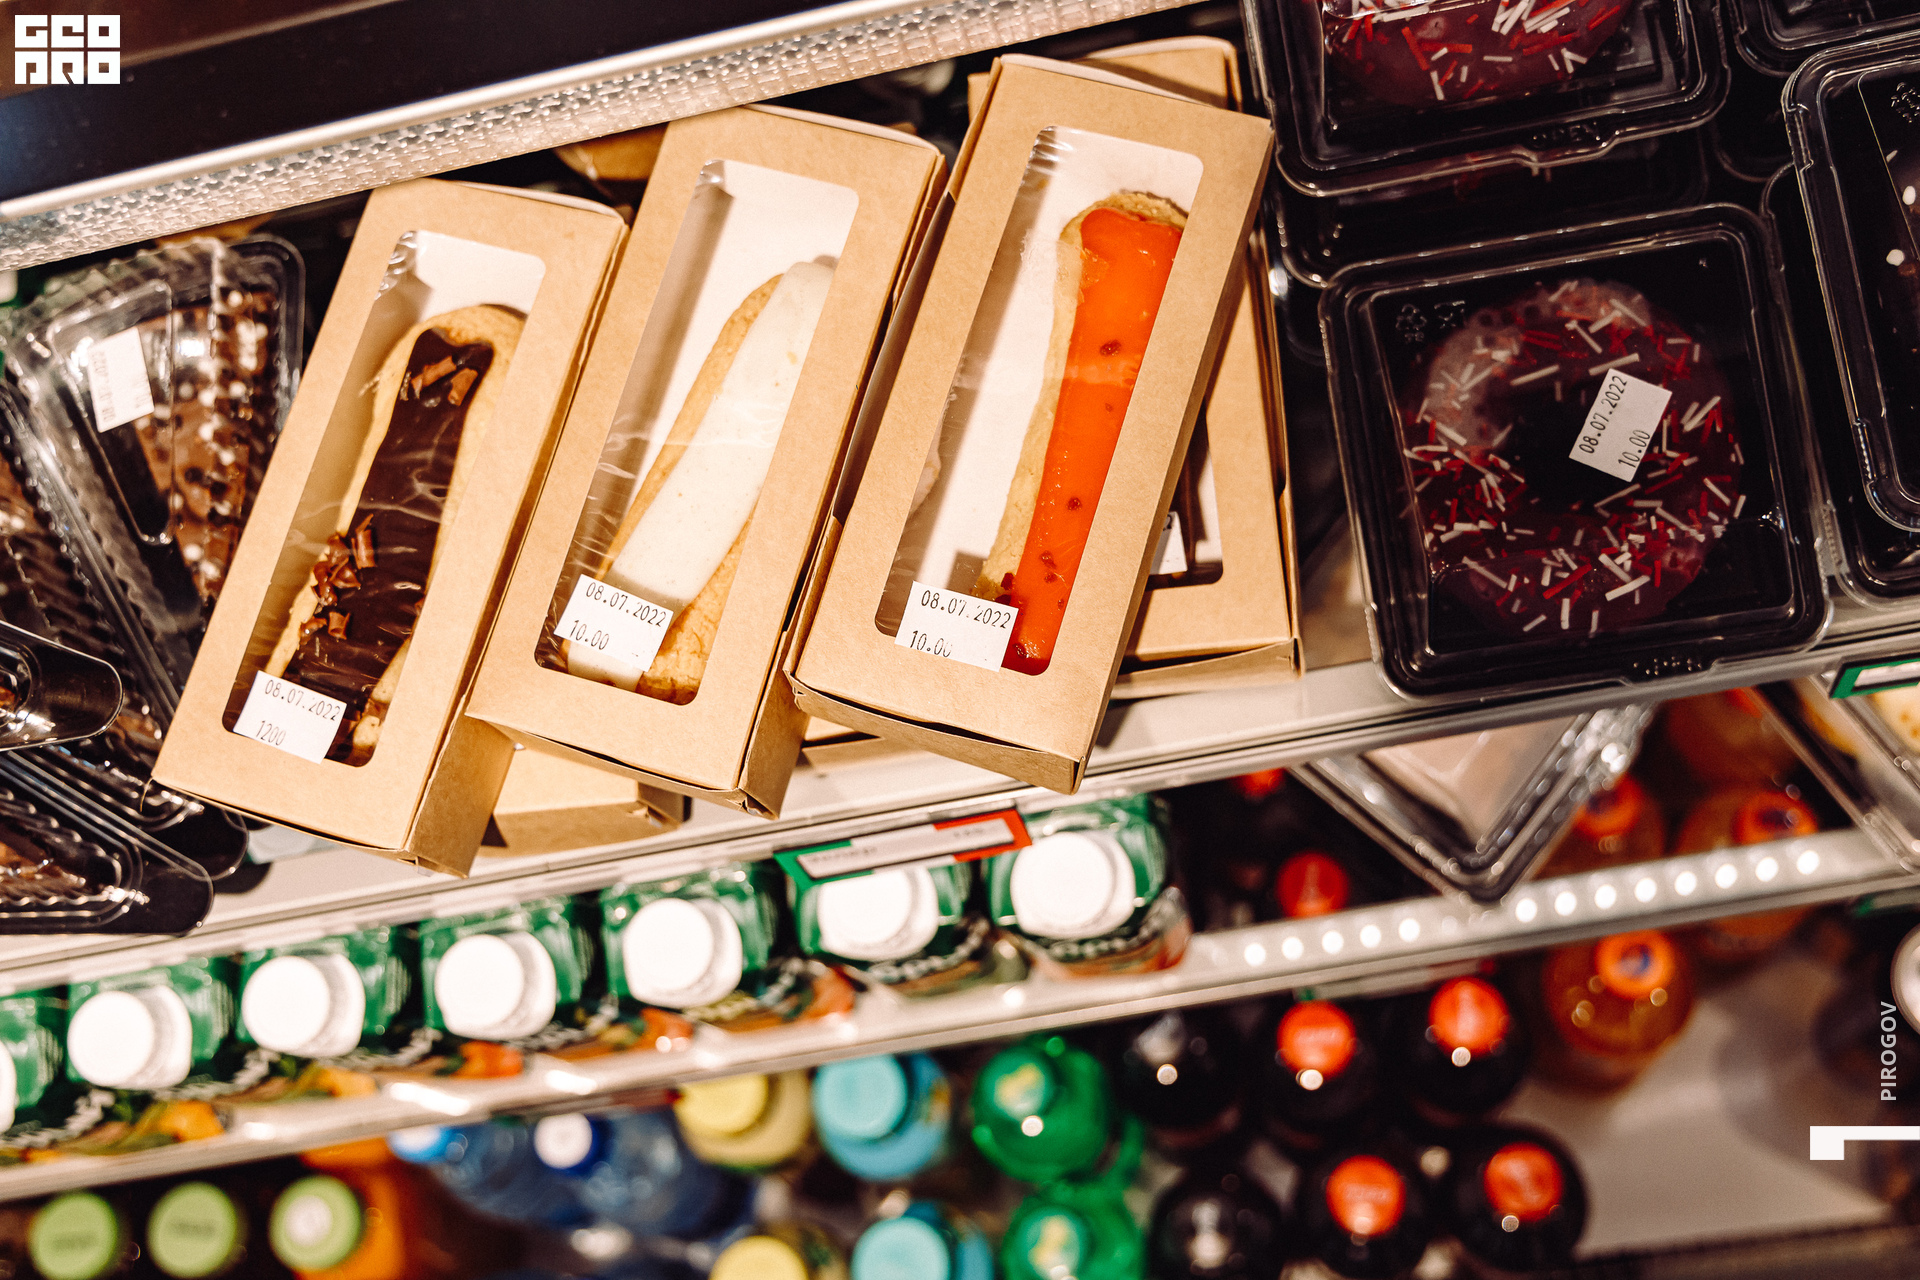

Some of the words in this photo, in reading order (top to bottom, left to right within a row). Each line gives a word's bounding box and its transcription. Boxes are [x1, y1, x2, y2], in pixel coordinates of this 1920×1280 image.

[1578, 375, 1627, 454] 08.07.2022
[1618, 429, 1651, 468] 10.00
[585, 582, 667, 627] 08.07.2022
[920, 589, 1012, 629] 08.07.2022
[569, 619, 610, 651] 10.00
[264, 679, 342, 721] 08.07.2022
[255, 720, 287, 746] 1200
